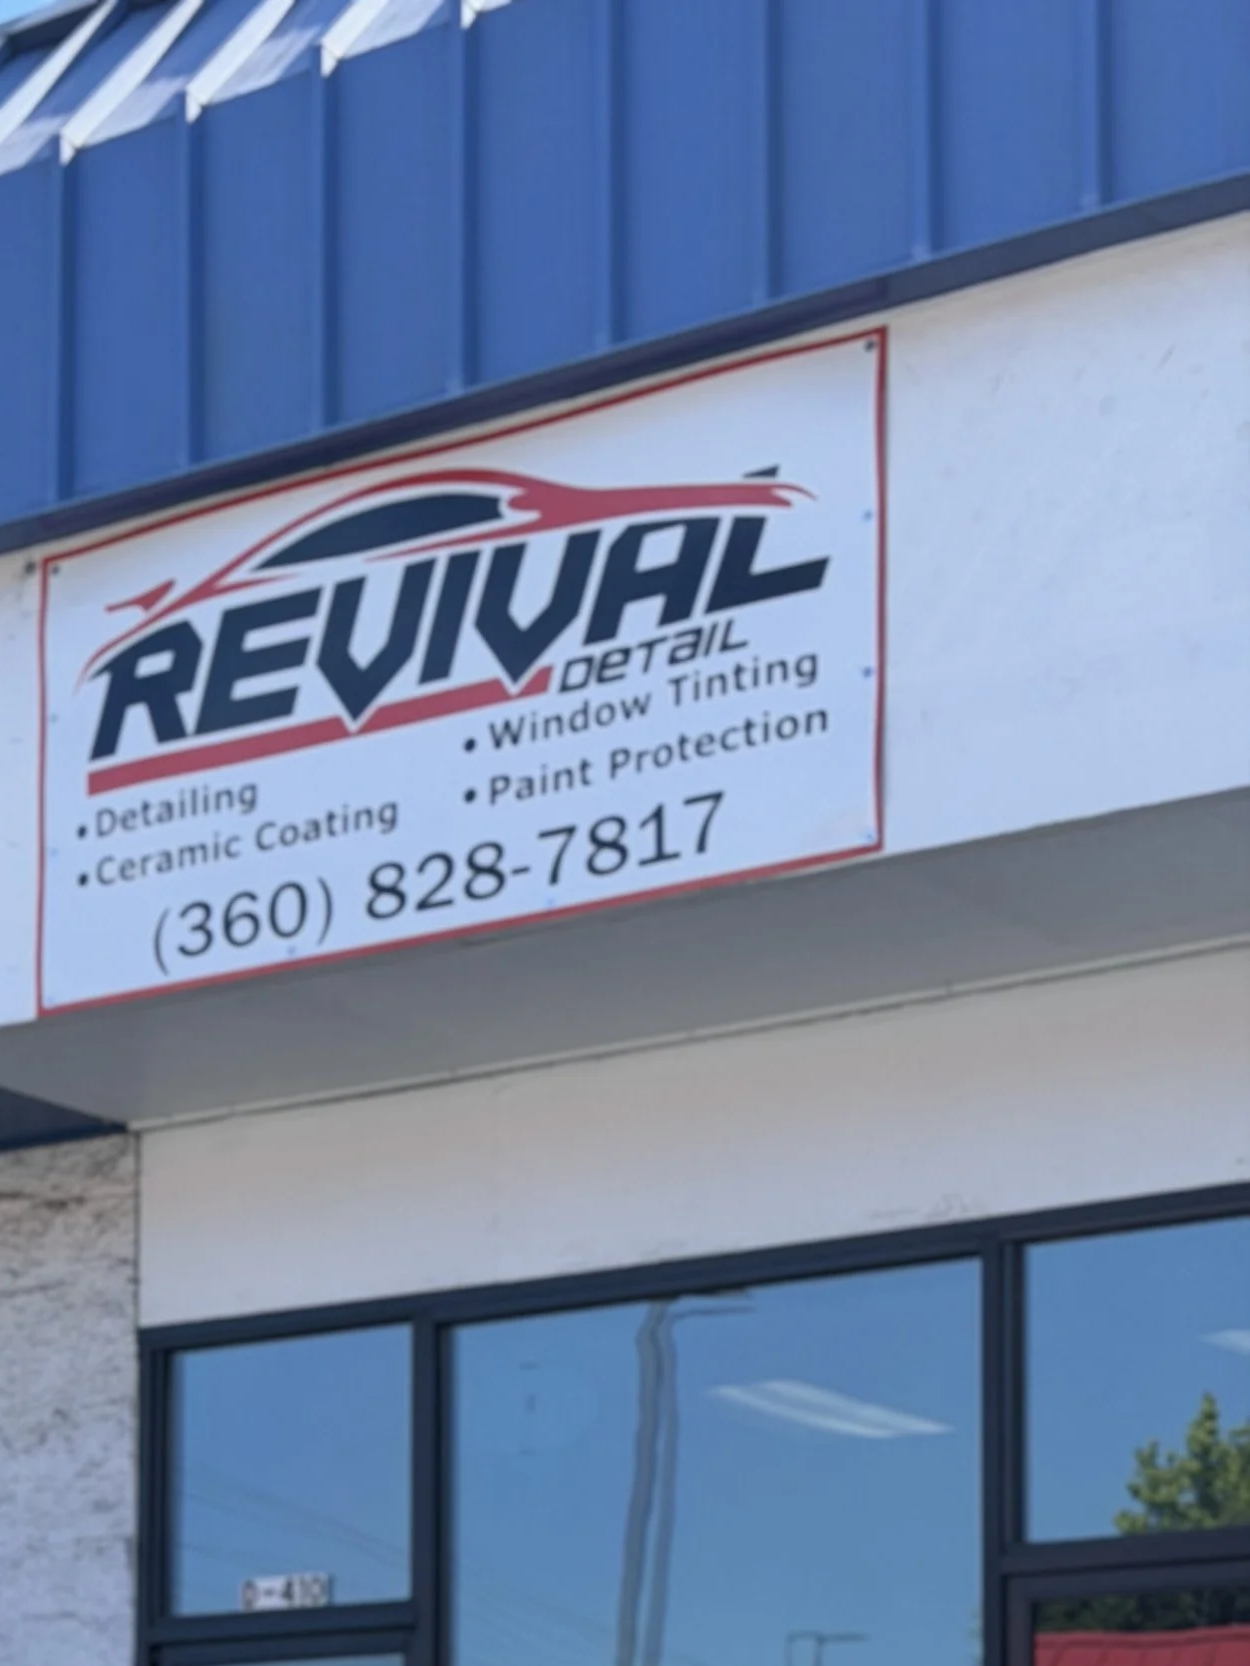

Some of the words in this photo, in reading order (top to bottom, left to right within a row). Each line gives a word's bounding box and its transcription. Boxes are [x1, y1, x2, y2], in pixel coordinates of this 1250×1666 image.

[88, 517, 831, 762] REVIVAL
[489, 694, 652, 750] Window
[669, 653, 819, 706] Tinting
[489, 758, 592, 806] Paint
[609, 708, 830, 780] Protection
[96, 783, 259, 838] Detailing
[96, 833, 242, 887] Ceramic
[255, 801, 399, 852] Coating
[154, 876, 333, 976] (360)
[366, 790, 726, 921] 828-7817
